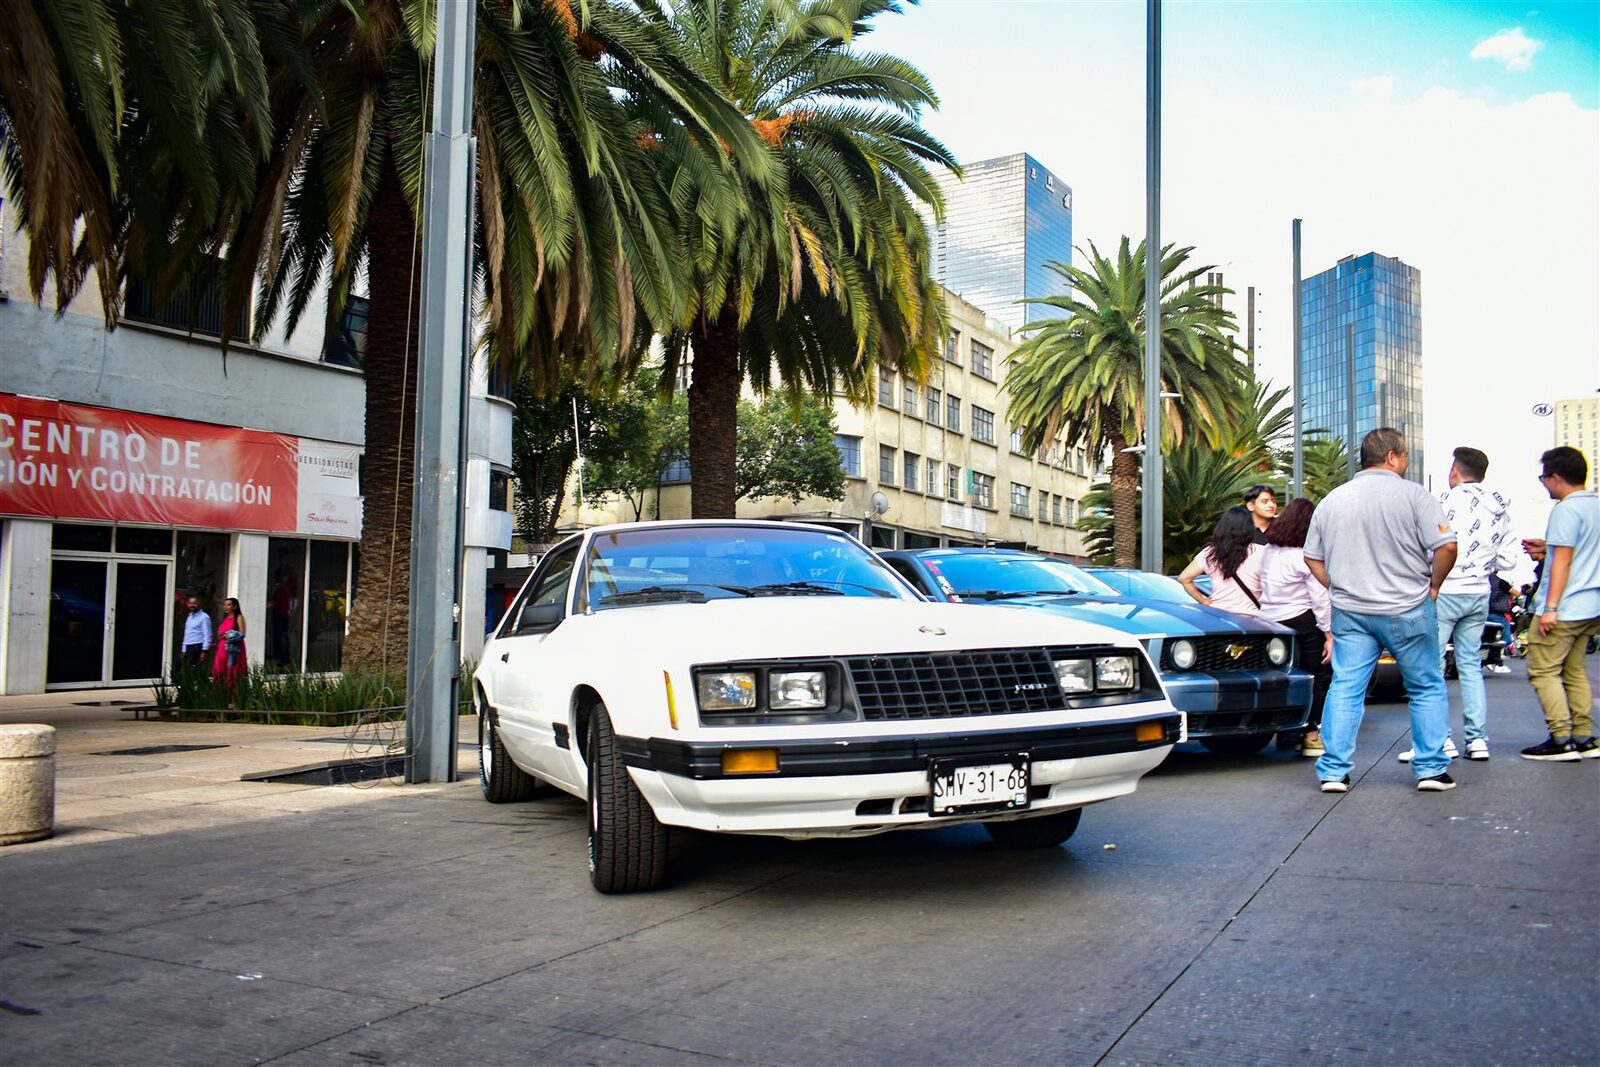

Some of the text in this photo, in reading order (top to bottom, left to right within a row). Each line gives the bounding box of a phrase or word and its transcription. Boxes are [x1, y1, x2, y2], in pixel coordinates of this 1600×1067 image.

[0, 412, 201, 470] CENTRO DE
[66, 467, 83, 489] Y
[90, 466, 272, 507] CONTRATACIÓN
